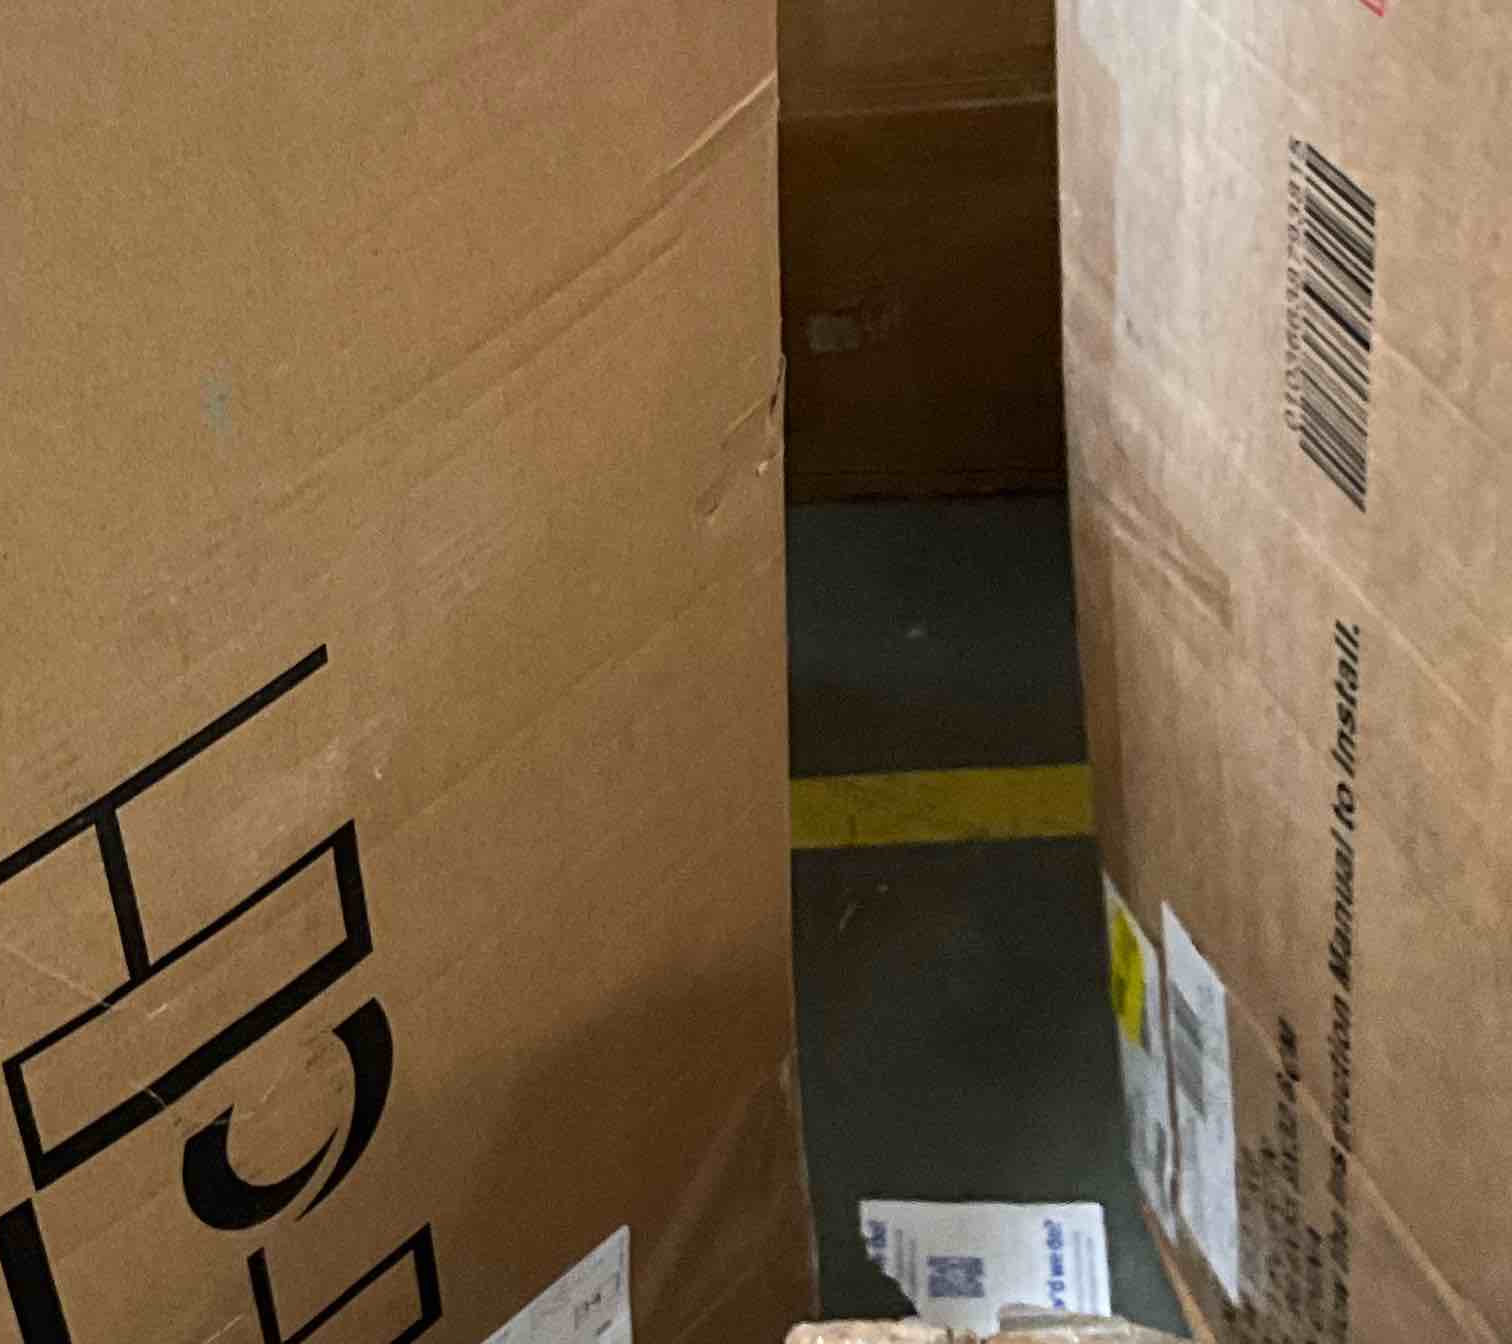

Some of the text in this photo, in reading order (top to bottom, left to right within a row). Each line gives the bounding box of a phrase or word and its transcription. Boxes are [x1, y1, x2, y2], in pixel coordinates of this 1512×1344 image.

[1331, 619, 1361, 779] Install.
[1331, 782, 1356, 833] to
[1328, 827, 1356, 992] Manual
